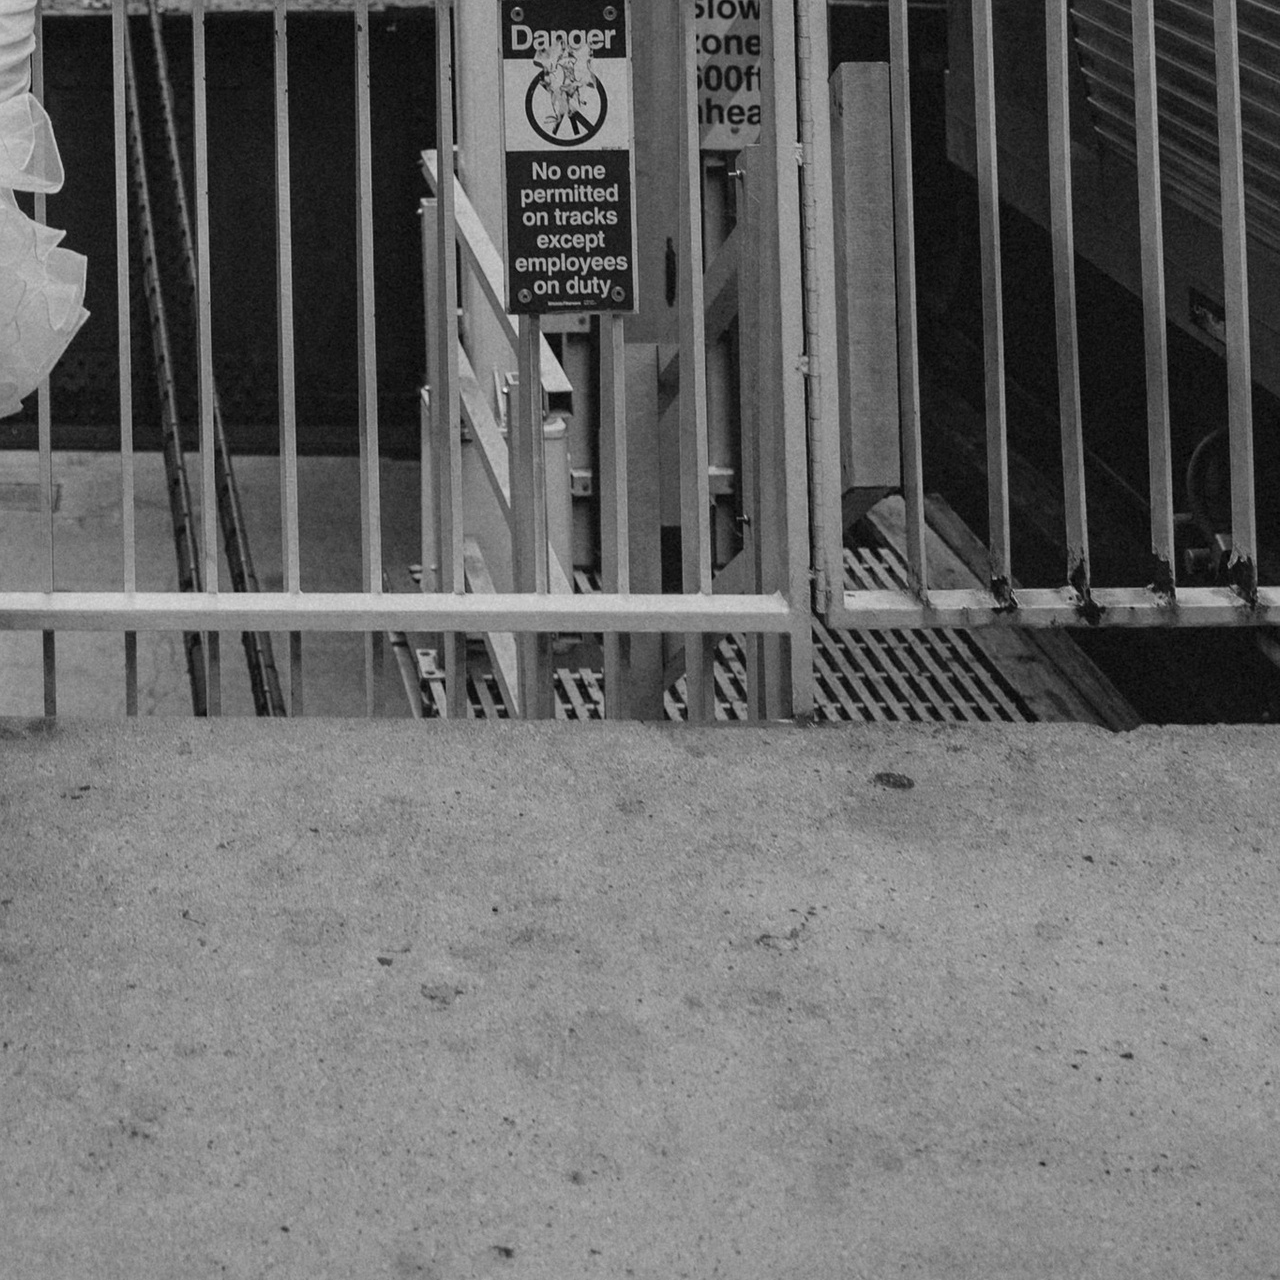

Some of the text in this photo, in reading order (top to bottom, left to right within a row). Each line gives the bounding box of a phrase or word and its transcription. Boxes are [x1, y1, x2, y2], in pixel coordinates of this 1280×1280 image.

[511, 24, 617, 51] Danger
[696, 33, 760, 56] one
[531, 161, 606, 181] No one
[520, 183, 619, 208] permitted
[522, 206, 618, 226] on tracks
[536, 230, 606, 253] except
[514, 252, 629, 277] employees
[533, 275, 612, 299] on duty
